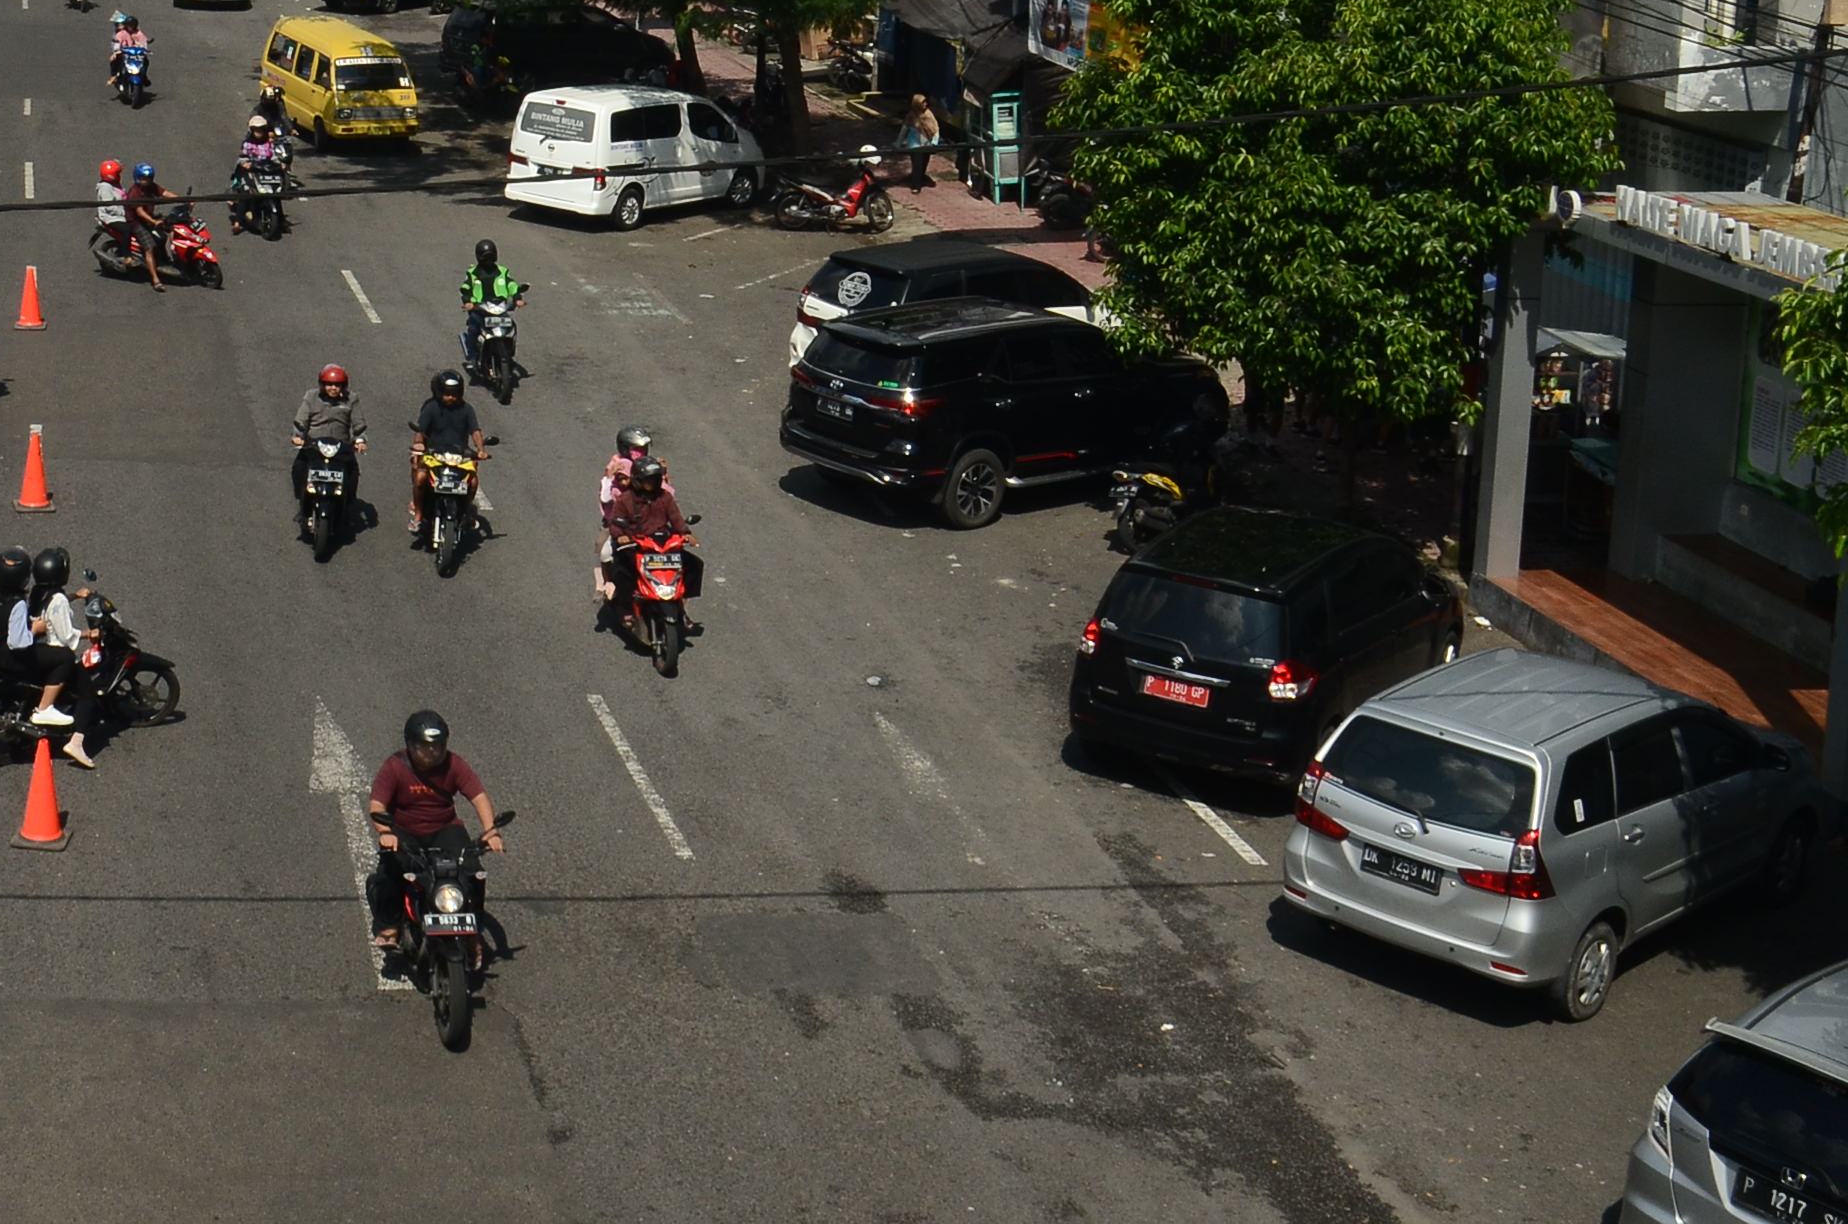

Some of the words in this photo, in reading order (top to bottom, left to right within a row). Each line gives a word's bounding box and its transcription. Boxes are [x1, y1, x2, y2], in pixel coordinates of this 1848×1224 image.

[1615, 184, 1680, 235] HALTE
[1678, 203, 1752, 261] NIAGA
[1743, 1176, 1755, 1193] P
[1770, 1189, 1808, 1219] 1217
